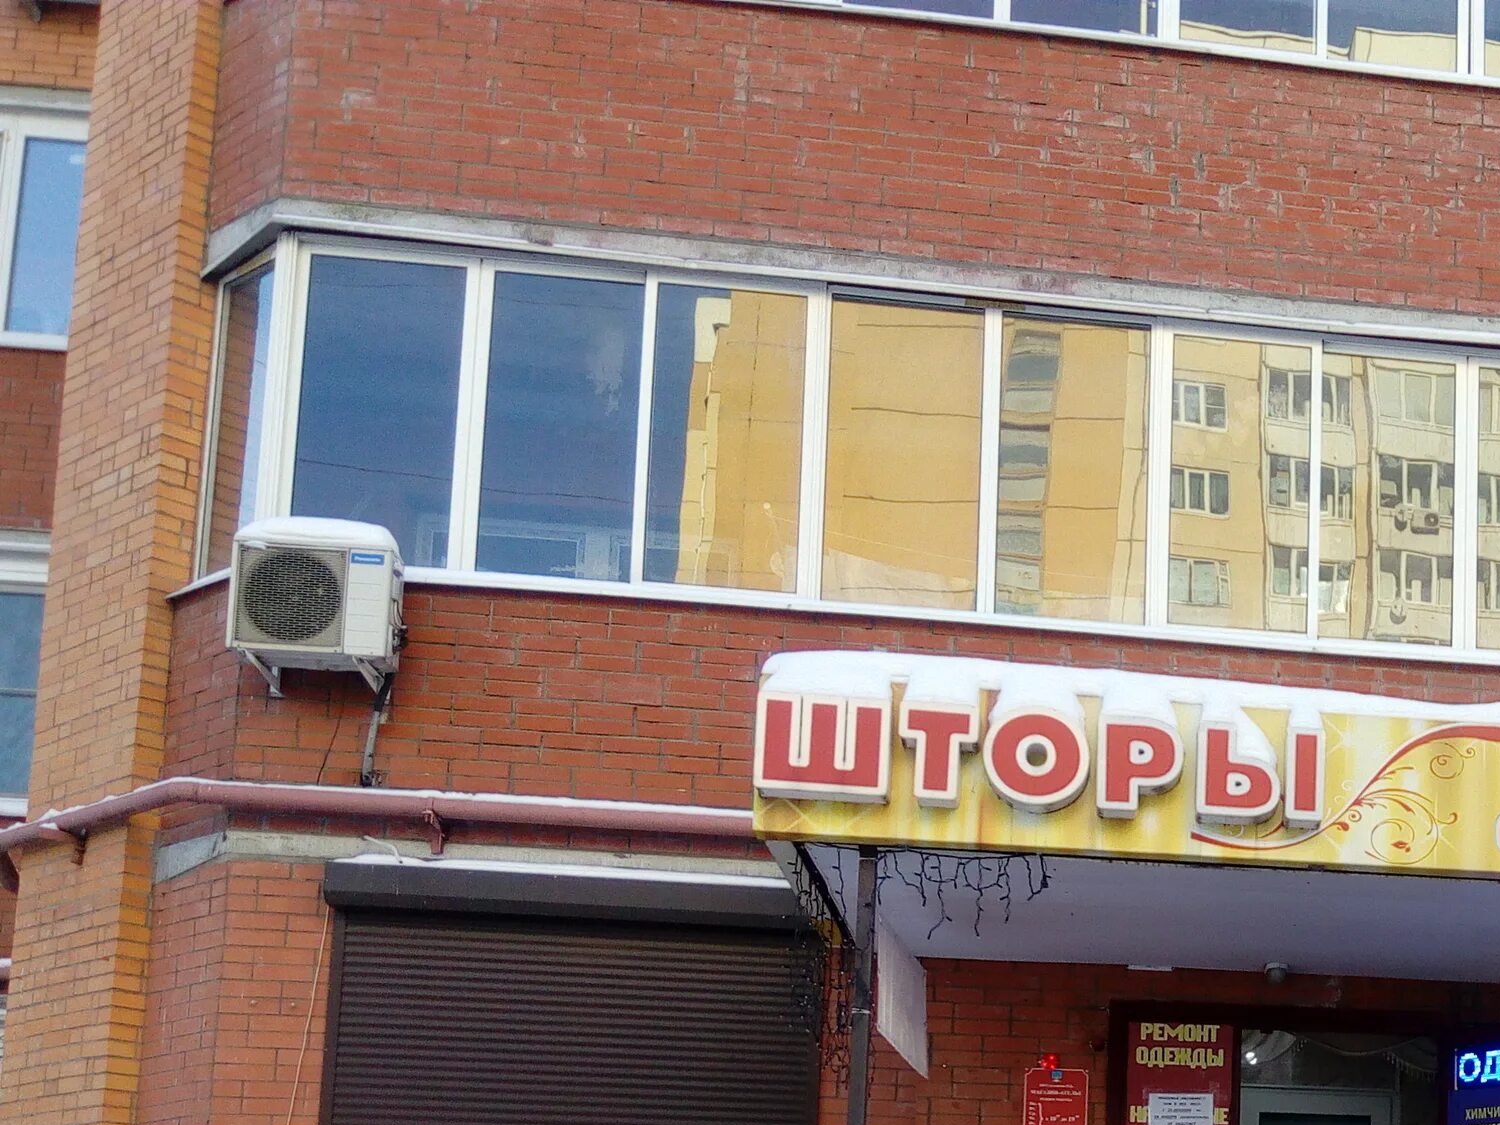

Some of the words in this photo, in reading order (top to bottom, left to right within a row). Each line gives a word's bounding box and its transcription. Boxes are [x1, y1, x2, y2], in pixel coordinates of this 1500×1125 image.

[756, 694, 1324, 820] ШТОРЫ
[1140, 1022, 1220, 1042] РЕМОНТ
[1136, 1046, 1224, 1069] ОДЕЖДЫ
